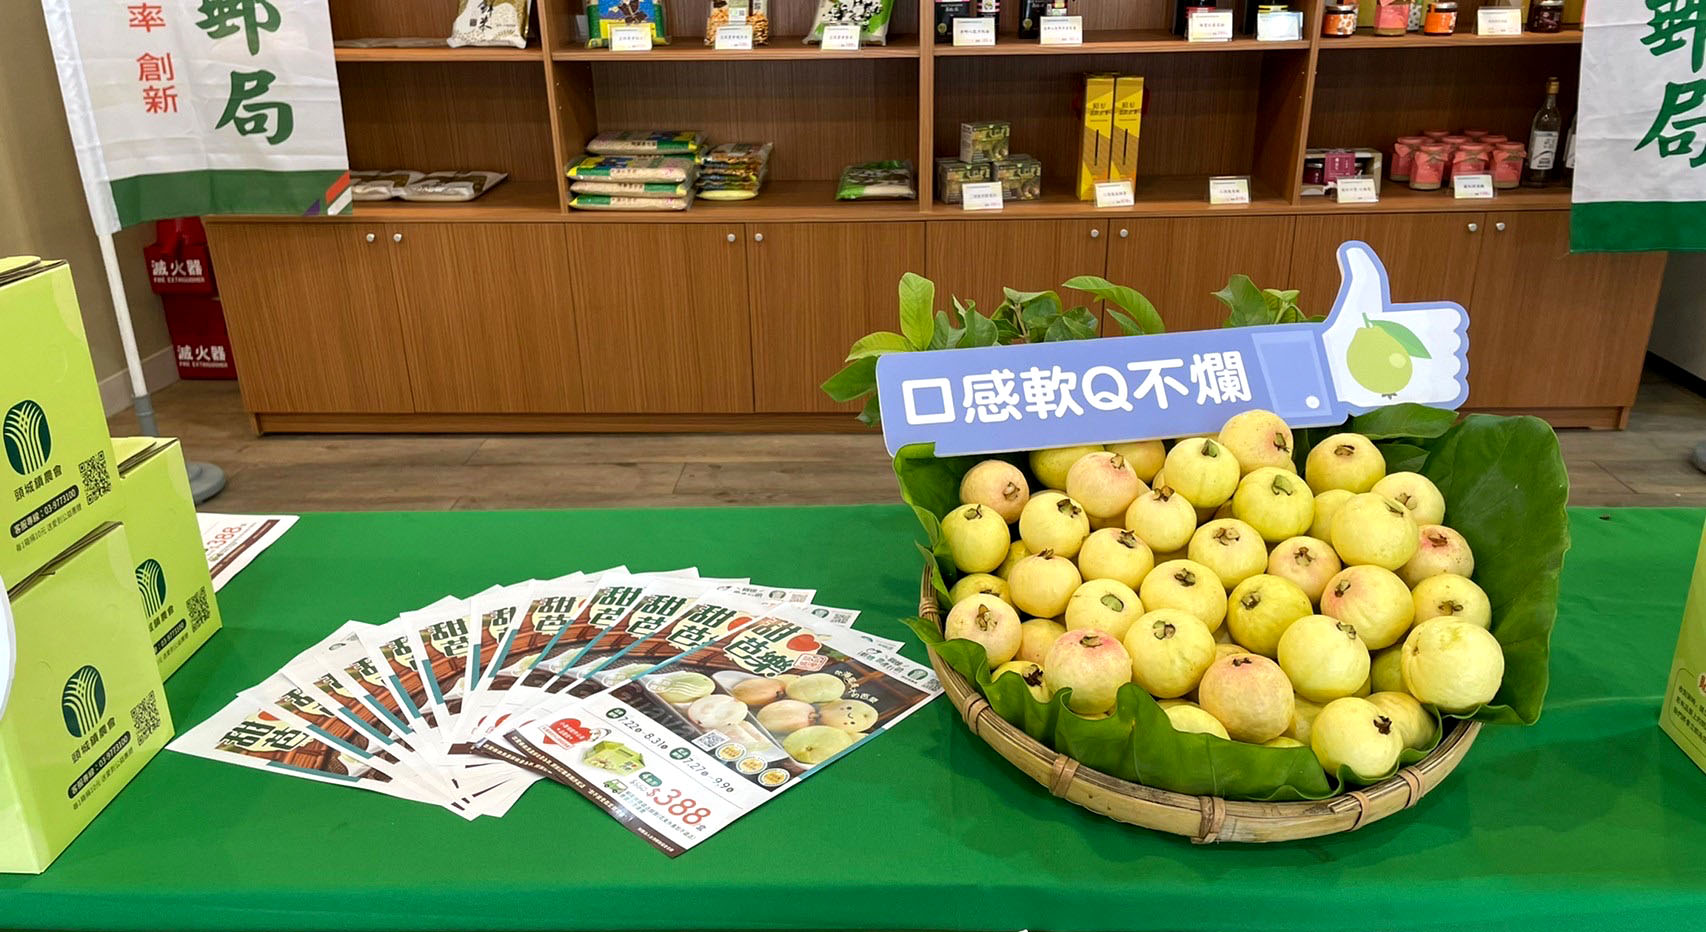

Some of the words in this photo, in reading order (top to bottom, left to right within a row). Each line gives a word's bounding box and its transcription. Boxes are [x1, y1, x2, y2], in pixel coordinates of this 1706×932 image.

[136, 52, 178, 114] 創新
[151, 259, 203, 276] 滅火器
[177, 344, 226, 361] 滅火器
[901, 349, 1254, 426] 口感軟Q不爛
[14, 464, 63, 502] 頭城鎮農會
[752, 616, 802, 643] 甜
[725, 636, 795, 677] 芭樂
[71, 716, 116, 765] 頭城鎮農會
